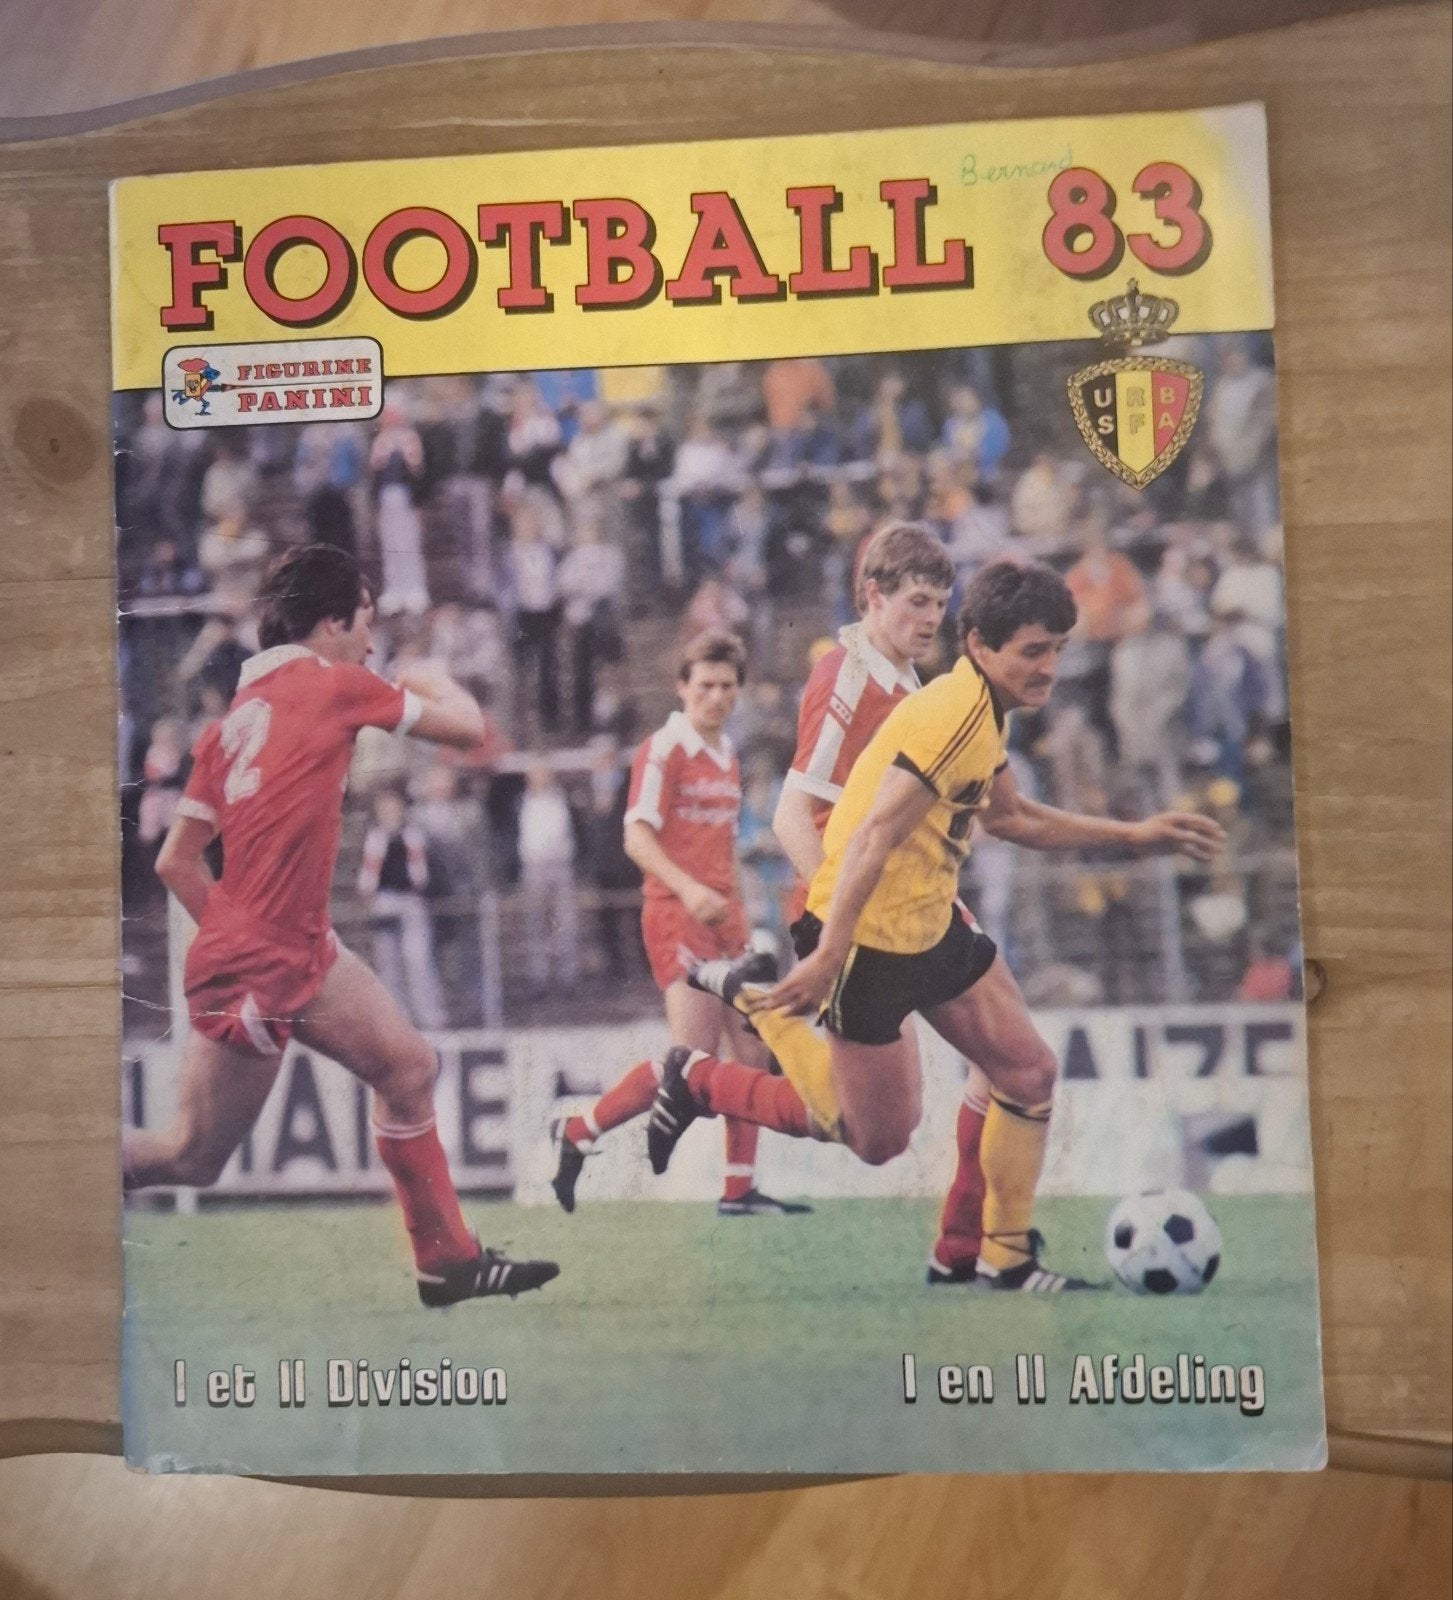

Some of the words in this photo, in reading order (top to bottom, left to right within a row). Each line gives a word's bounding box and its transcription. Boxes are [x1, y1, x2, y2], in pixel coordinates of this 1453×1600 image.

[158, 178, 974, 332] FOOTBALL
[1042, 161, 1212, 281] 83
[237, 358, 372, 381] FIGURINE
[237, 386, 373, 413] PANINI
[220, 697, 272, 805] 2
[206, 1363, 256, 1408] et
[278, 1358, 306, 1408] II
[327, 1357, 508, 1408] Division
[938, 1363, 995, 1404] en
[1016, 1353, 1047, 1405] II
[1069, 1352, 1266, 1416] Afdeling
